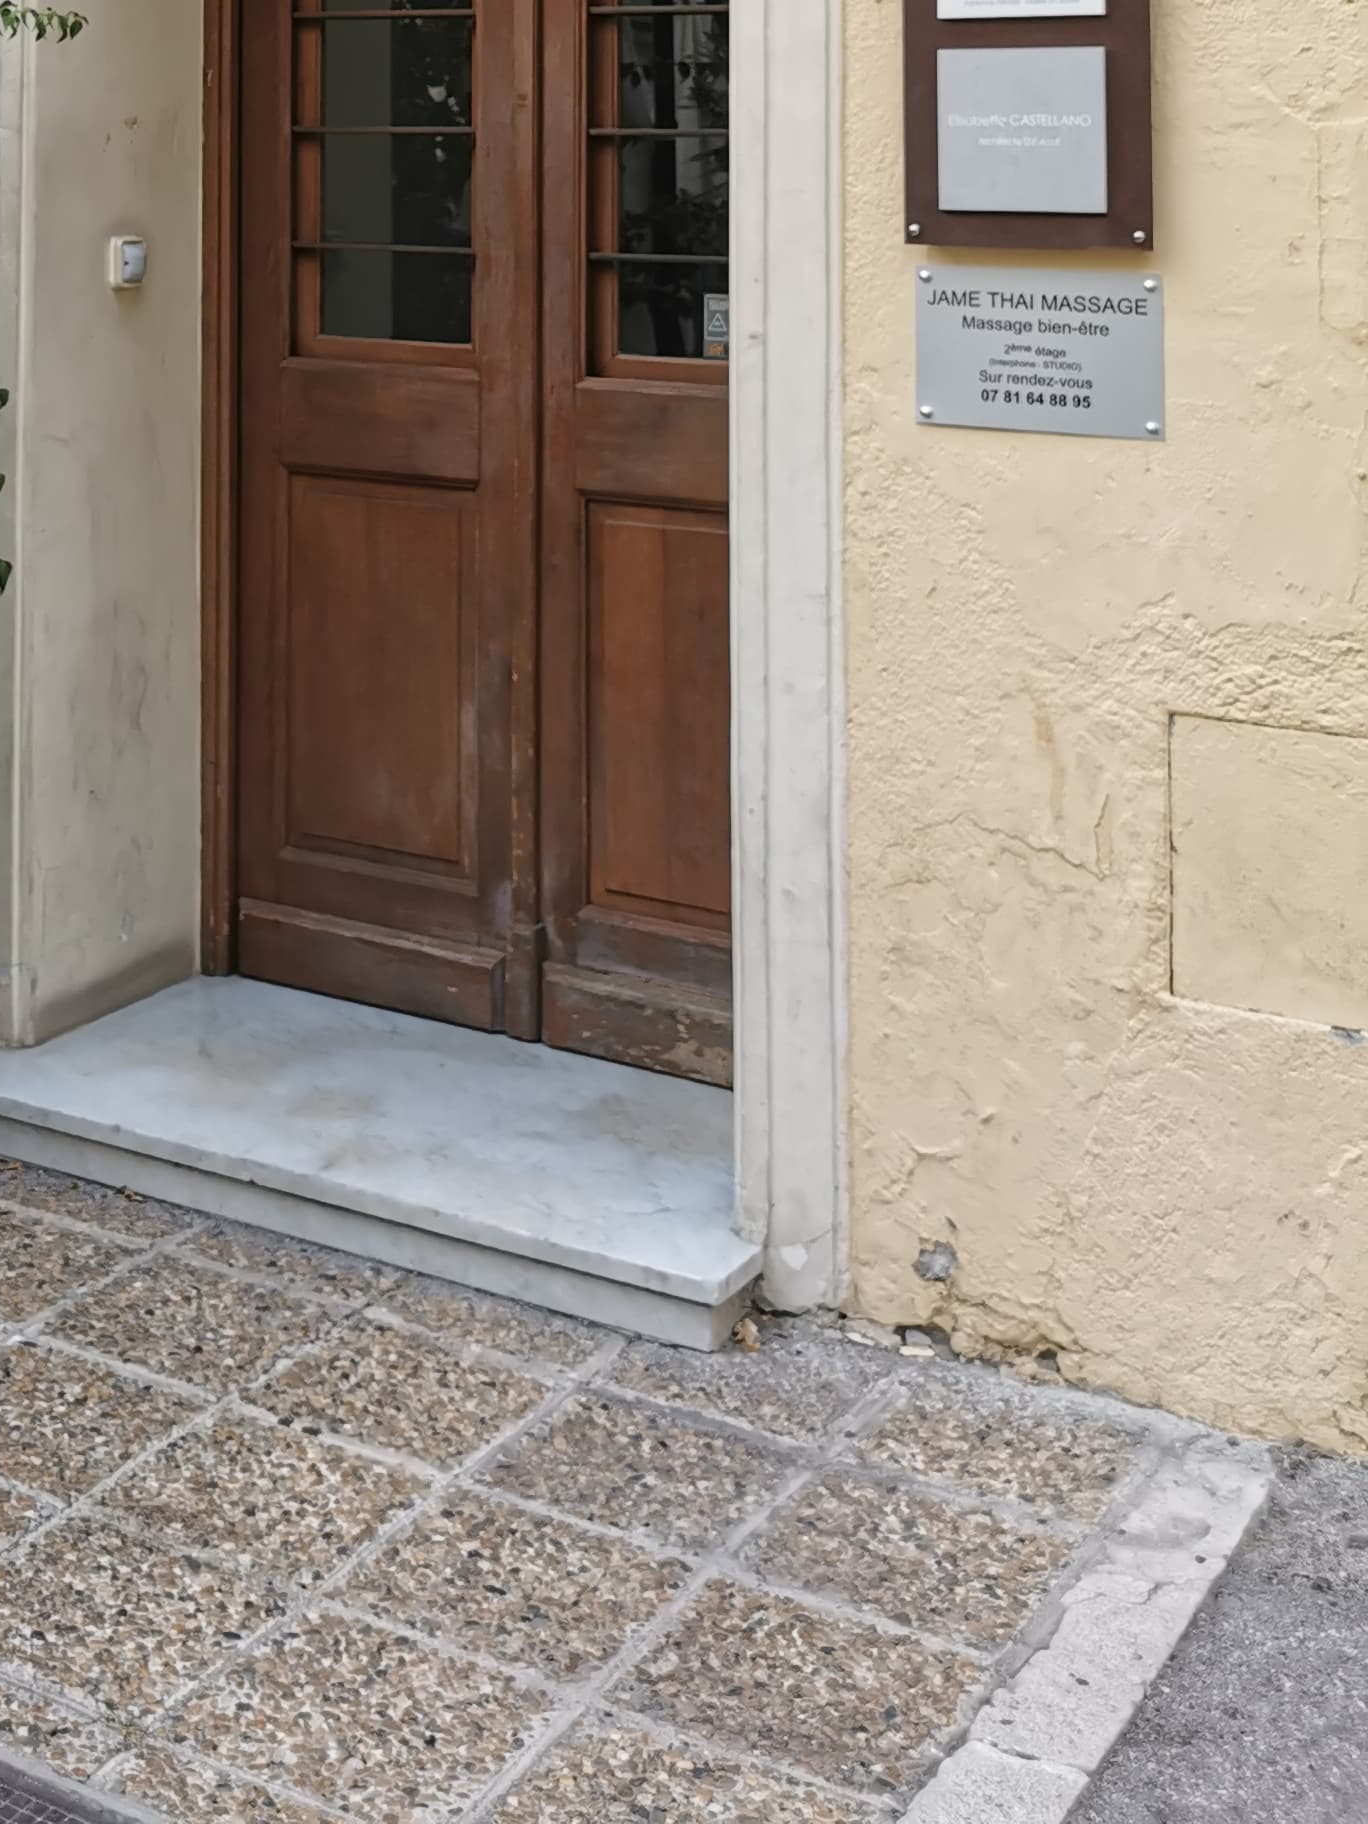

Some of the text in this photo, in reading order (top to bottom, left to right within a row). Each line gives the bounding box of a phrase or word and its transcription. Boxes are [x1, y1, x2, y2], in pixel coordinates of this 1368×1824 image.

[1009, 112, 1093, 127] CASTELLANO
[927, 289, 1149, 316] JAME THAI MASSAGE
[961, 315, 1110, 337] Massage bien-être
[1035, 345, 1067, 359] étage
[978, 369, 1094, 390] Sur rendez-vous
[980, 389, 1092, 409] 07 81 64 88 95
